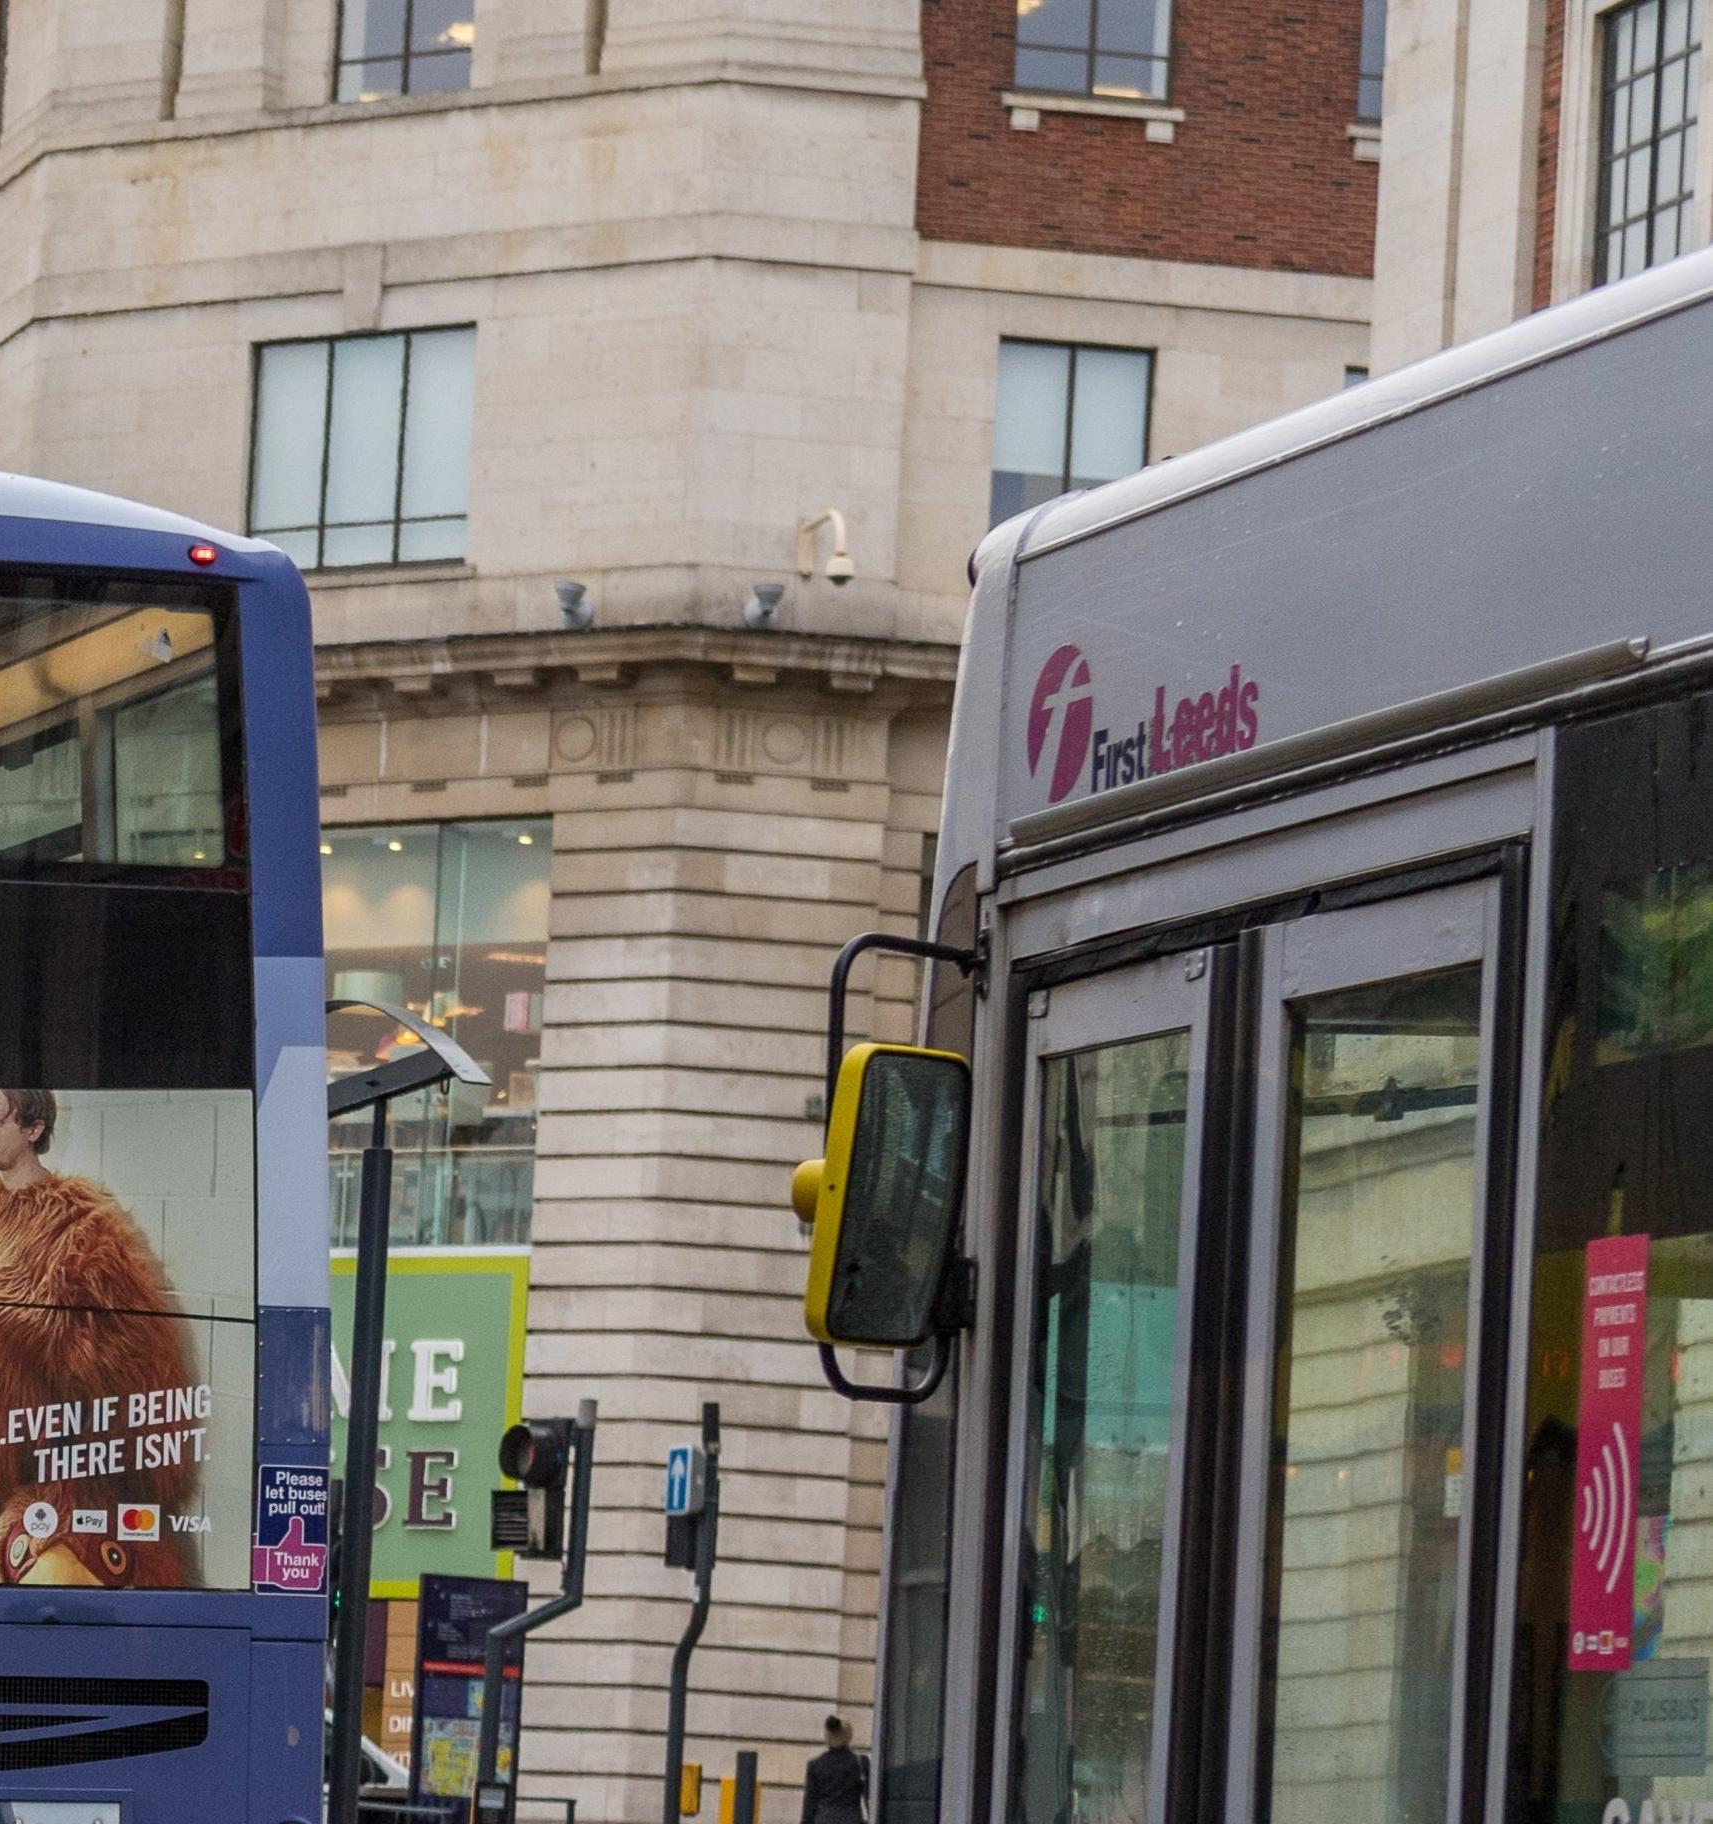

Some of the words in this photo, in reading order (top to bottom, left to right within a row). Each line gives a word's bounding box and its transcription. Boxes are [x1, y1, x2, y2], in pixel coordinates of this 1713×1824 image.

[1091, 719, 1146, 794] First
[1151, 663, 1260, 774] Leeds
[1589, 1271, 1645, 1297] CONTACTLESS
[1593, 1303, 1636, 1327] PAYMENTS
[1598, 1338, 1610, 1358] ON
[1611, 1336, 1630, 1357] OUR
[1598, 1368, 1627, 1389] BUSES
[92, 1396, 119, 1432] IF
[128, 1383, 212, 1429] BEING
[33, 1437, 125, 1484] THERE
[135, 1428, 212, 1470] ISN'T.
[275, 1470, 323, 1487] Please
[265, 1486, 285, 1501] let
[289, 1487, 327, 1502] buses
[268, 1501, 297, 1517] pull
[300, 1502, 325, 1516] out!
[30, 1520, 51, 1533] pay
[84, 1514, 103, 1530] Pay
[167, 1514, 212, 1533] VISA
[274, 1551, 319, 1567] Thank
[282, 1567, 310, 1583] you
